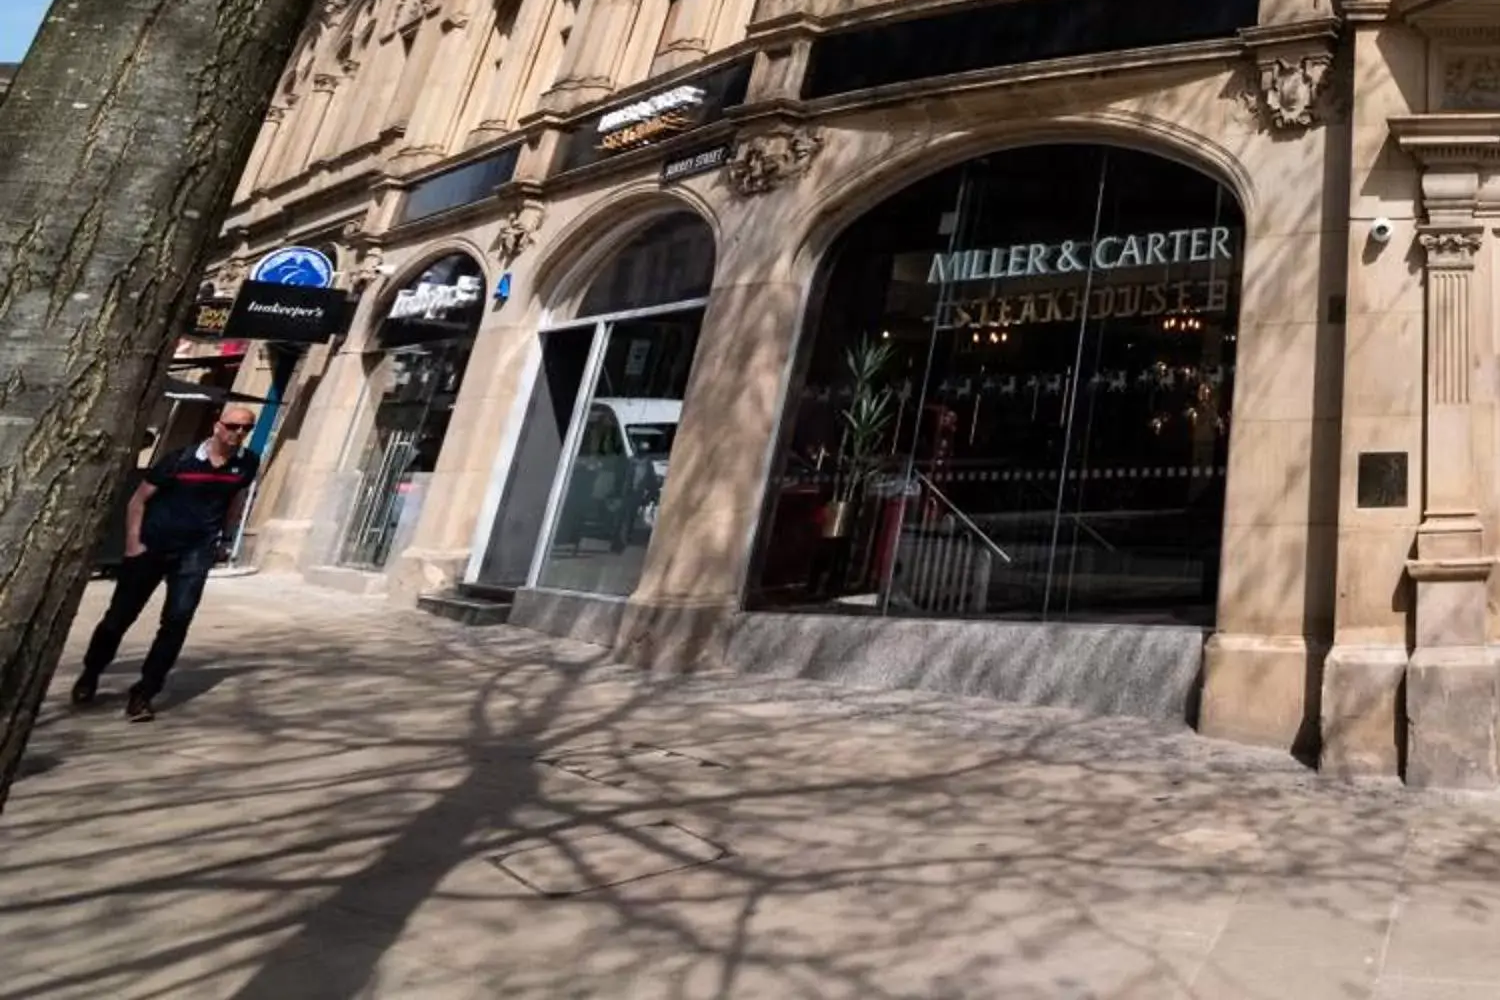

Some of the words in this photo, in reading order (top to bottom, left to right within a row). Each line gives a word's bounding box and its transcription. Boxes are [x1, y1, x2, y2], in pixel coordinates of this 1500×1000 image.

[927, 242, 1048, 283] MILLER
[1056, 239, 1085, 273] &
[1095, 226, 1233, 269] CARTER
